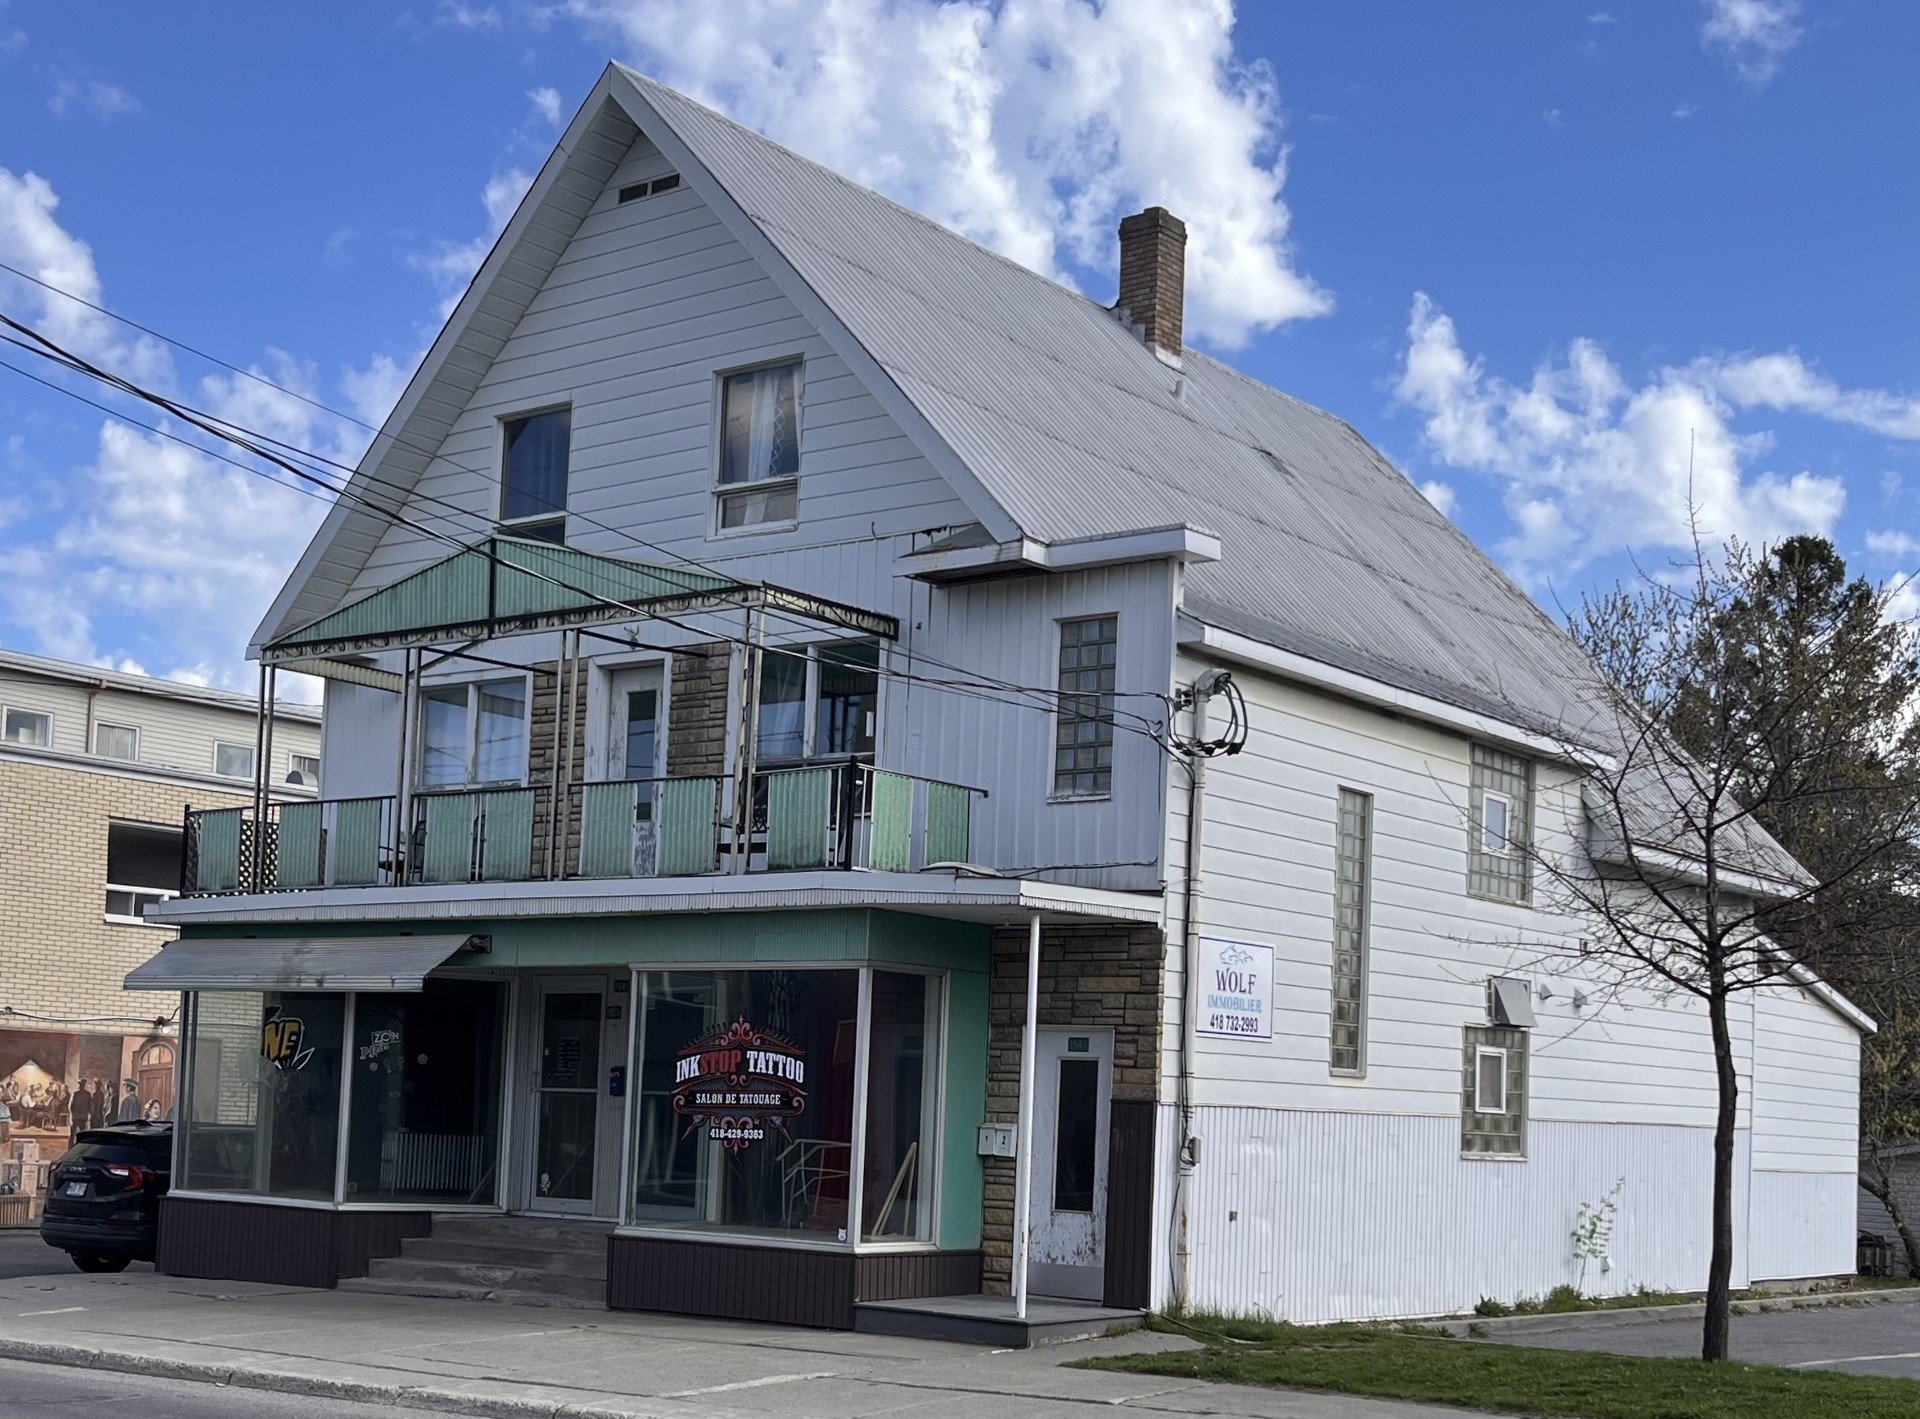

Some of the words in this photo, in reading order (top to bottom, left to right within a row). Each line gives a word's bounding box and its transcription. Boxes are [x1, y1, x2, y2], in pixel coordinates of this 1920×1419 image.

[1216, 967, 1256, 994] WOLF
[1207, 995, 1262, 1013] IMMOBILIER
[1210, 1013, 1223, 1030] 418
[1226, 1015, 1258, 1033] 732-2993
[746, 1051, 804, 1083] TATTOO
[696, 1093, 723, 1104] SALON
[725, 1094, 737, 1104] DE
[739, 1094, 781, 1105] TATOUAGE
